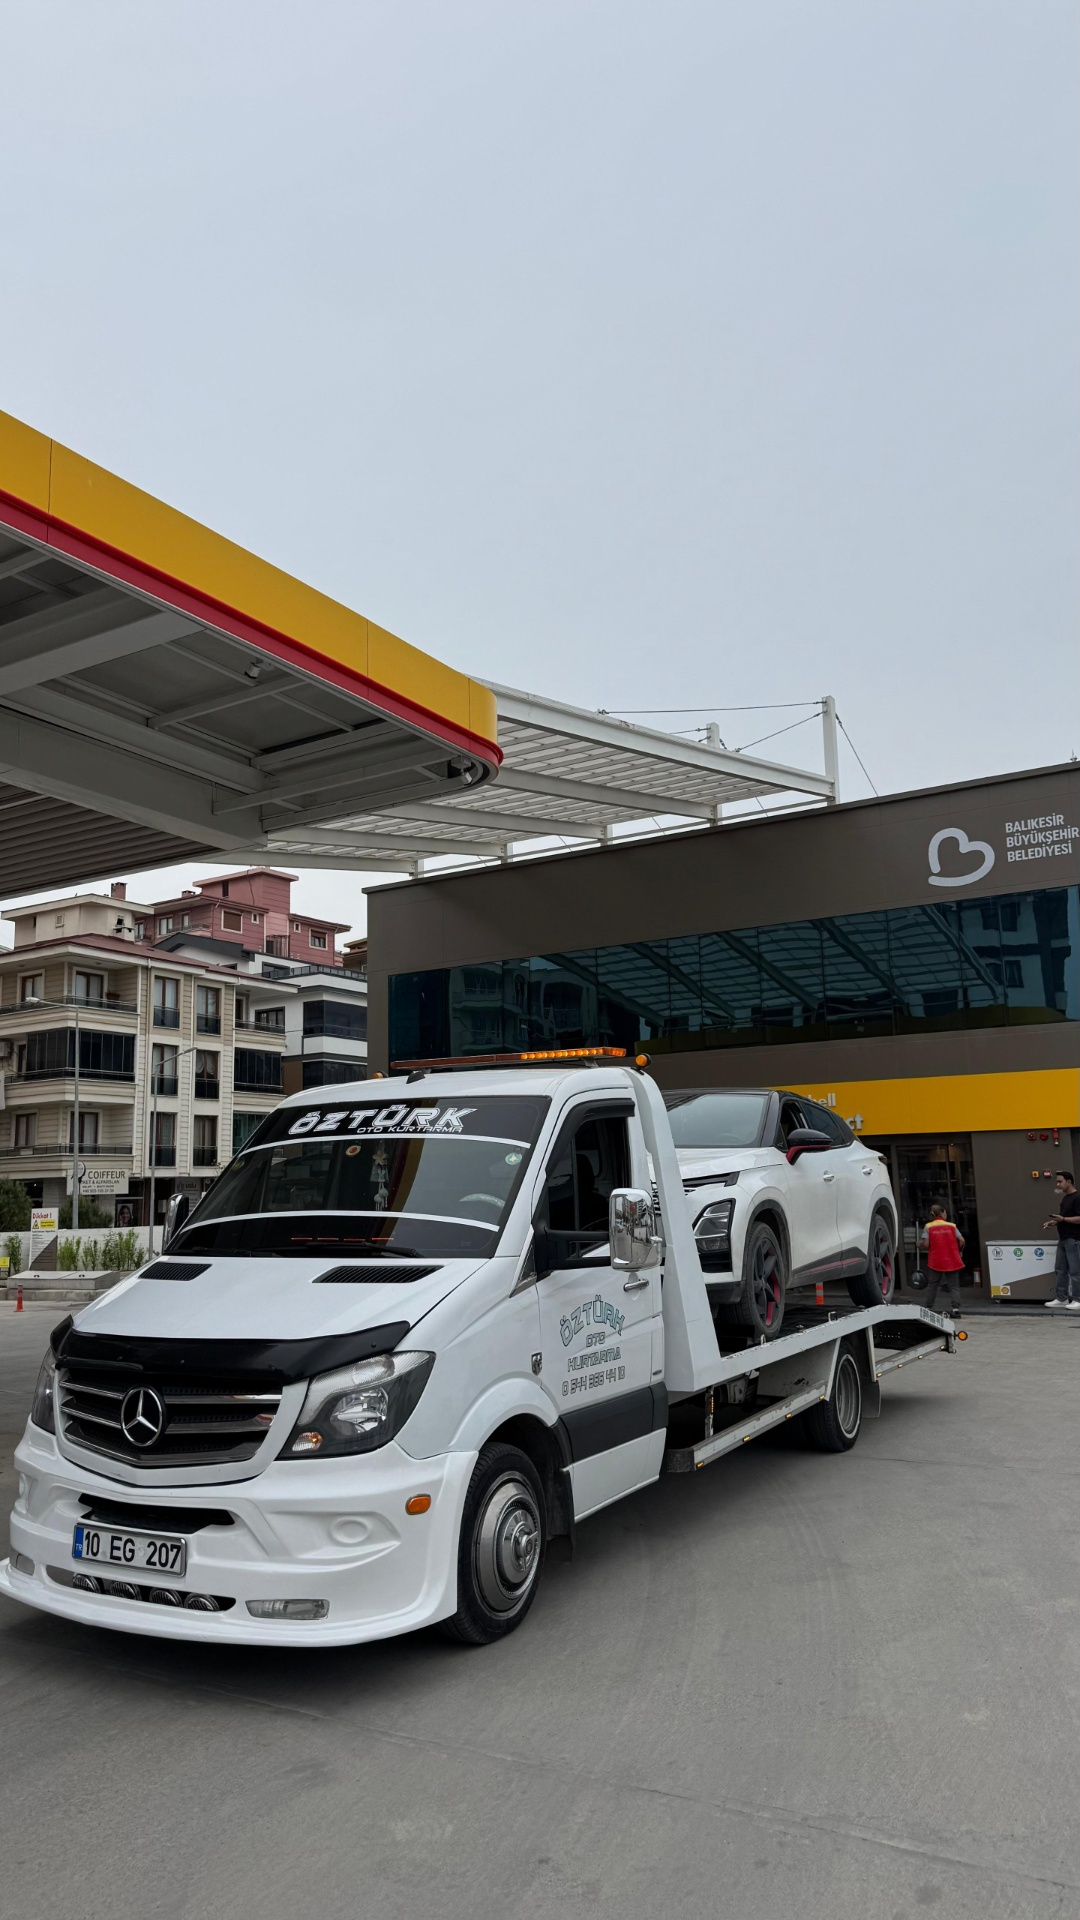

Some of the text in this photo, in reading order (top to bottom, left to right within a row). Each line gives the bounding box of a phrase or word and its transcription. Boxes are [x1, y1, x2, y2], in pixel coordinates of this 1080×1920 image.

[1005, 812, 1065, 833] BALIKESİR
[1006, 825, 1080, 848] BÜYÜKŞEHİR
[1007, 840, 1073, 863] BELEDİYESİ
[288, 1104, 478, 1135] ÖZTÜRK
[356, 1125, 463, 1134] OTO KURTARMA
[87, 1170, 126, 1180] COIFFEUR
[559, 1294, 626, 1348] ÖZTÜRK
[586, 1331, 606, 1348] OTO
[75, 1543, 83, 1551] TR
[84, 1530, 182, 1569] 10 EG 207
